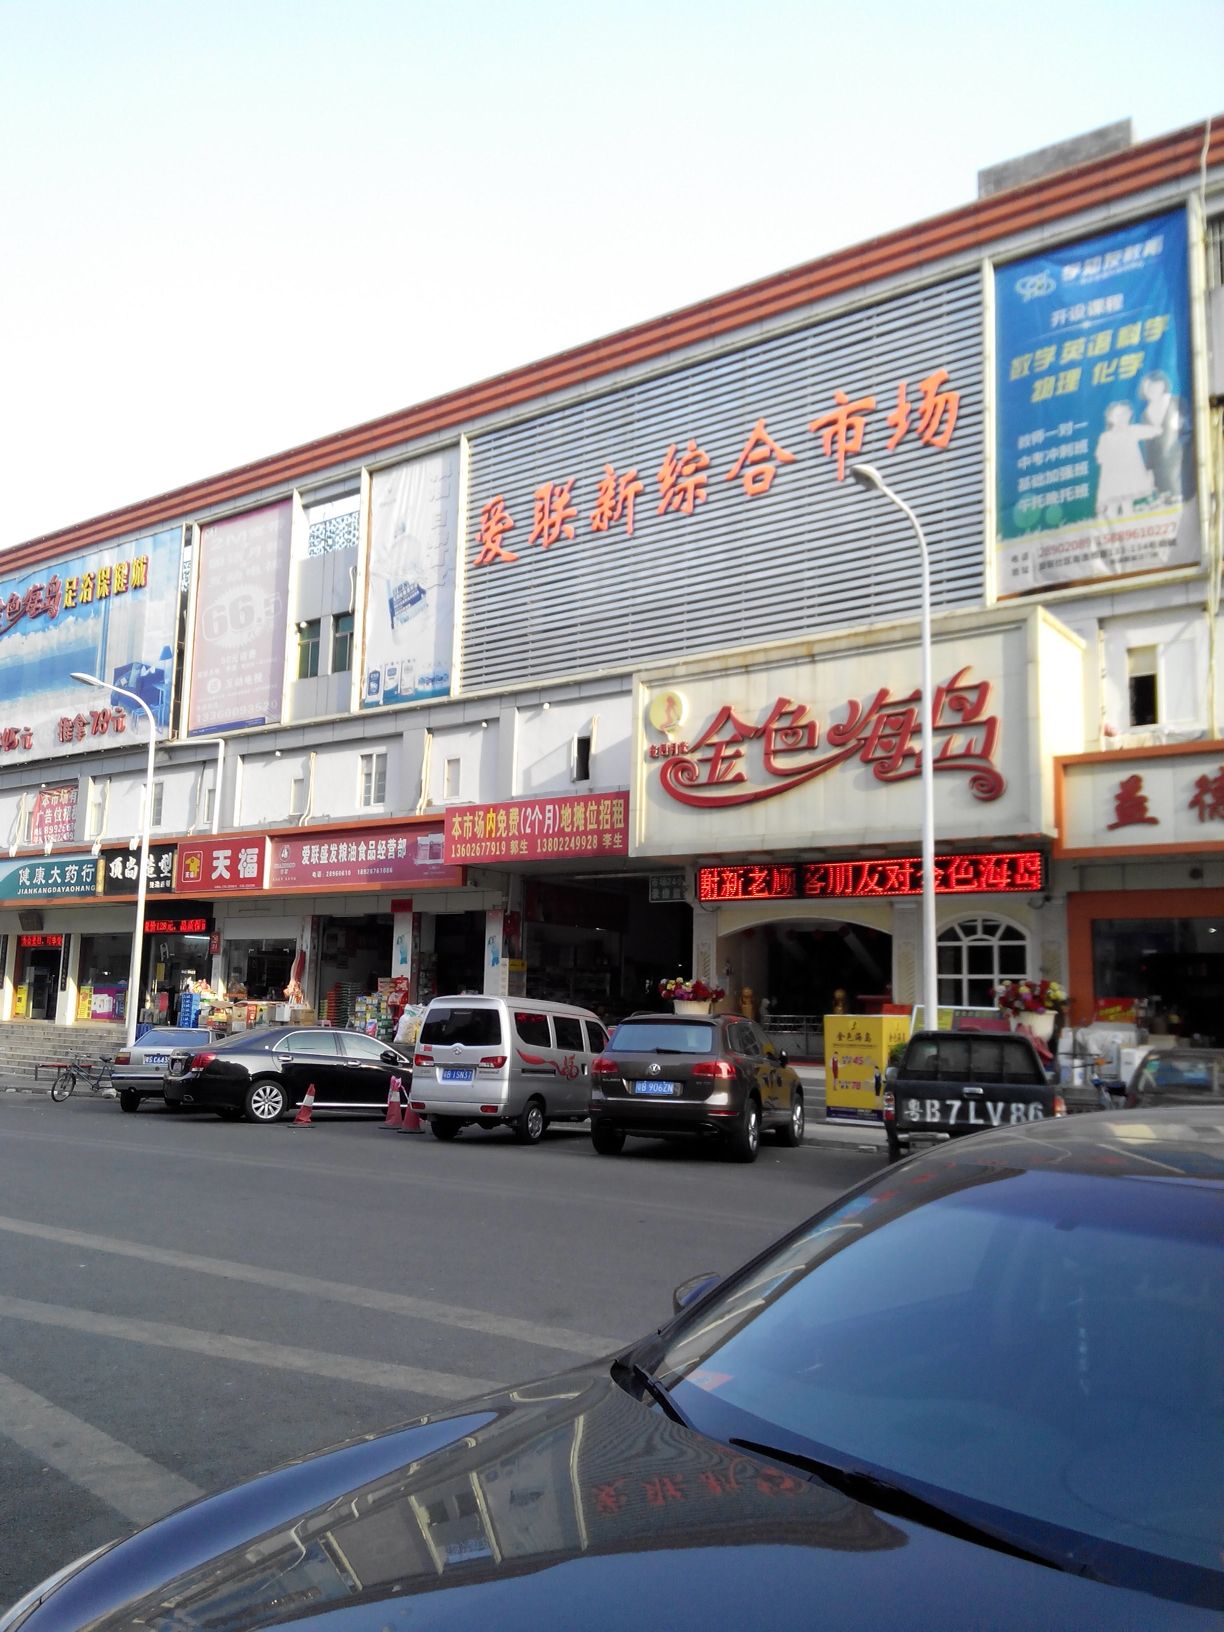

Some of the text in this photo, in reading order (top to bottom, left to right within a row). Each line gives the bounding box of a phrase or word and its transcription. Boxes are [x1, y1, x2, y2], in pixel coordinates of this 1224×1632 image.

[1092, 351, 1145, 386] 化学
[473, 369, 961, 566] 爱联新综合市场
[0, 573, 61, 634] 色海岛
[64, 554, 149, 609] 足浴保健城
[660, 665, 1006, 808] 金色海岛
[451, 798, 625, 840] 本市场内免费(2个月)地摊位招租
[301, 838, 407, 866] 爱联盛发粮油食品经营部
[451, 841, 506, 857] 13602677919
[536, 836, 598, 853] 13802249928
[18, 863, 95, 886] 健康大药行
[211, 848, 259, 880] 天福
[17, 884, 96, 895] JIANKANGDAYAOHANG
[904, 1098, 1044, 1126] 粤B7LV86
